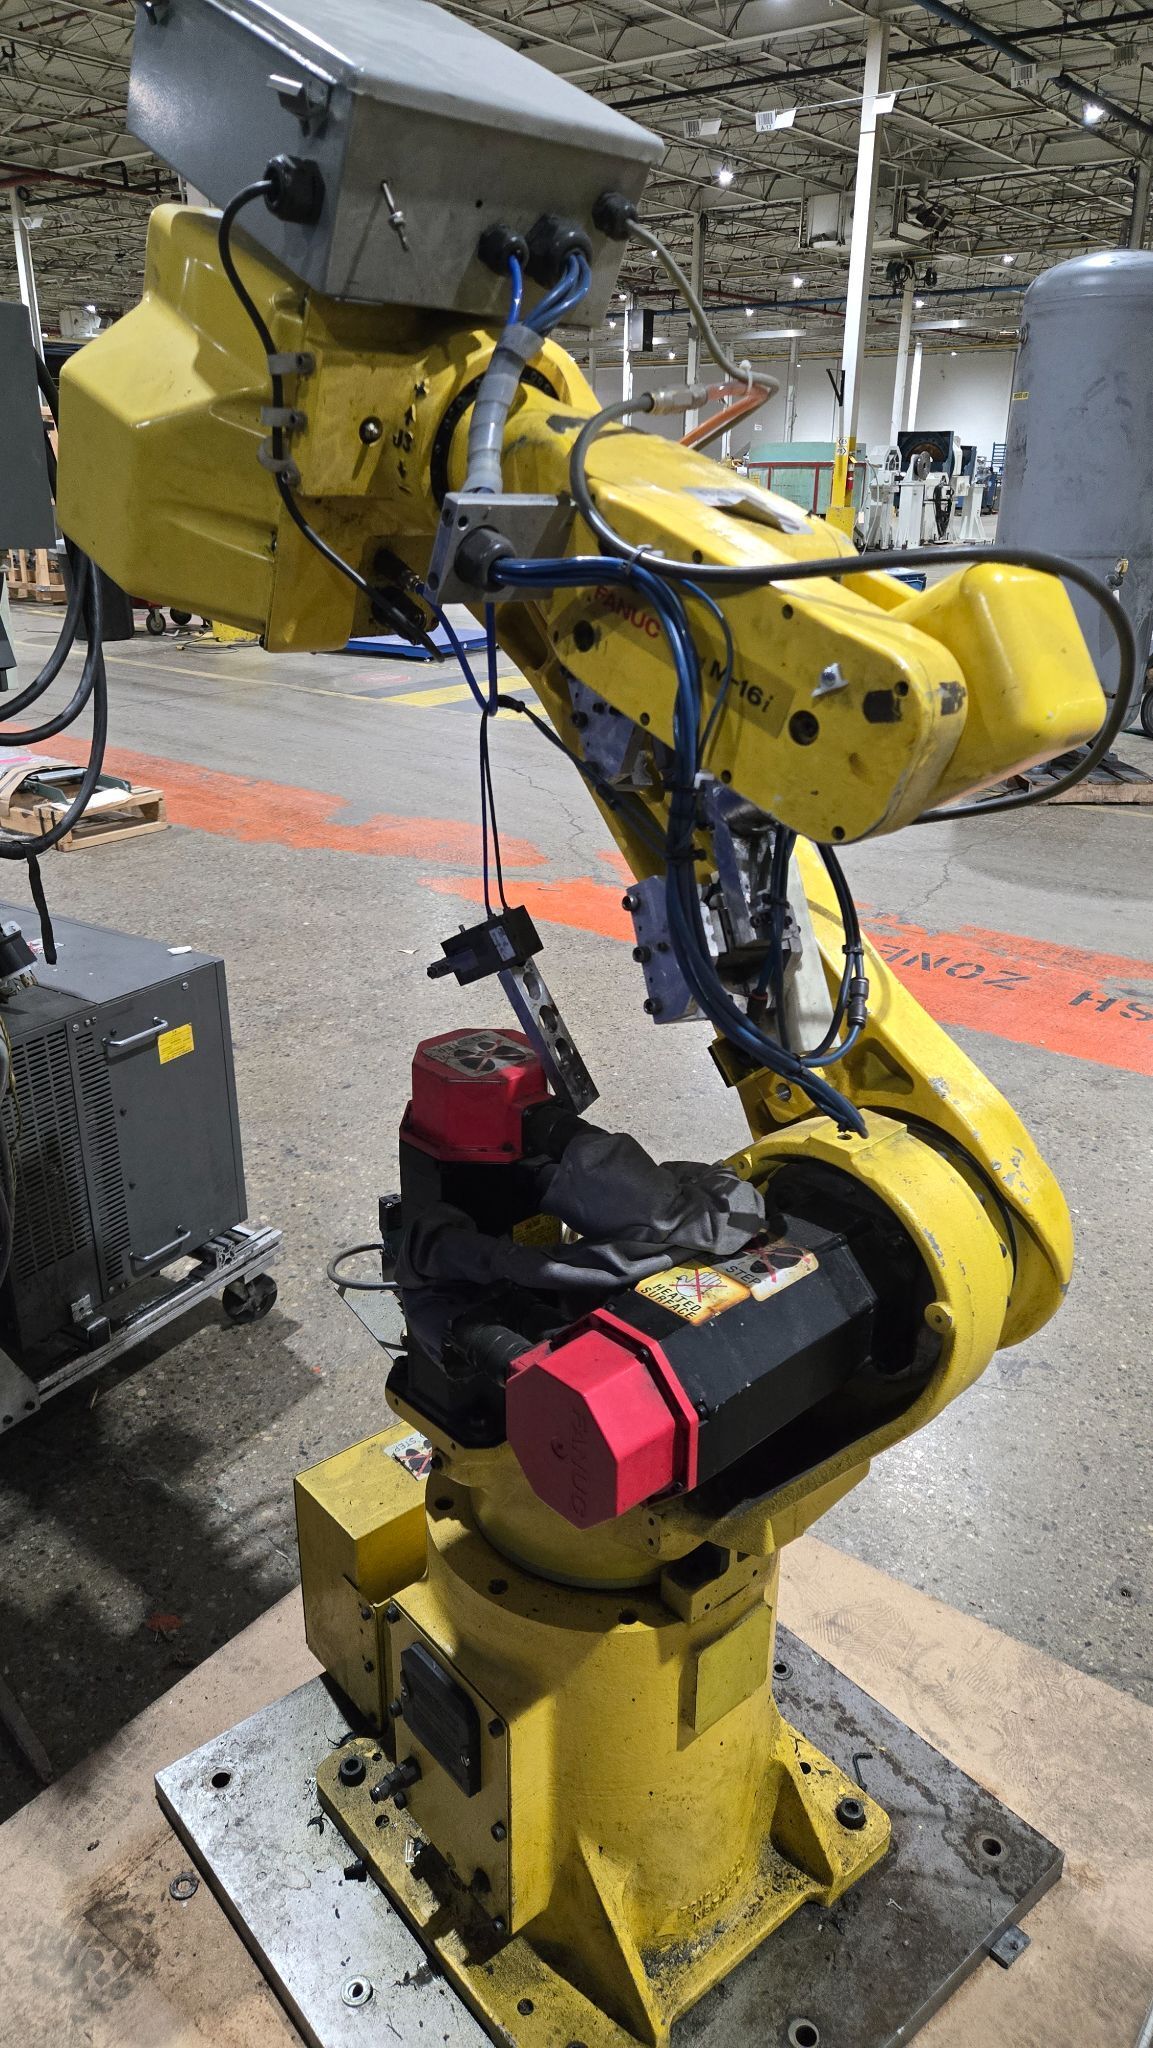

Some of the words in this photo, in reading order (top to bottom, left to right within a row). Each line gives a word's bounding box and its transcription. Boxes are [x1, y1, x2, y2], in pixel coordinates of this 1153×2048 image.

[392, 429, 413, 453] J3
[594, 584, 662, 639] FANUC
[709, 659, 775, 713] M-16i
[879, 943, 1033, 991] ZONE
[726, 1265, 762, 1284] STEP
[640, 1286, 696, 1320] SURFACE
[652, 1283, 702, 1312] HEATED
[394, 1437, 417, 1452] STEP
